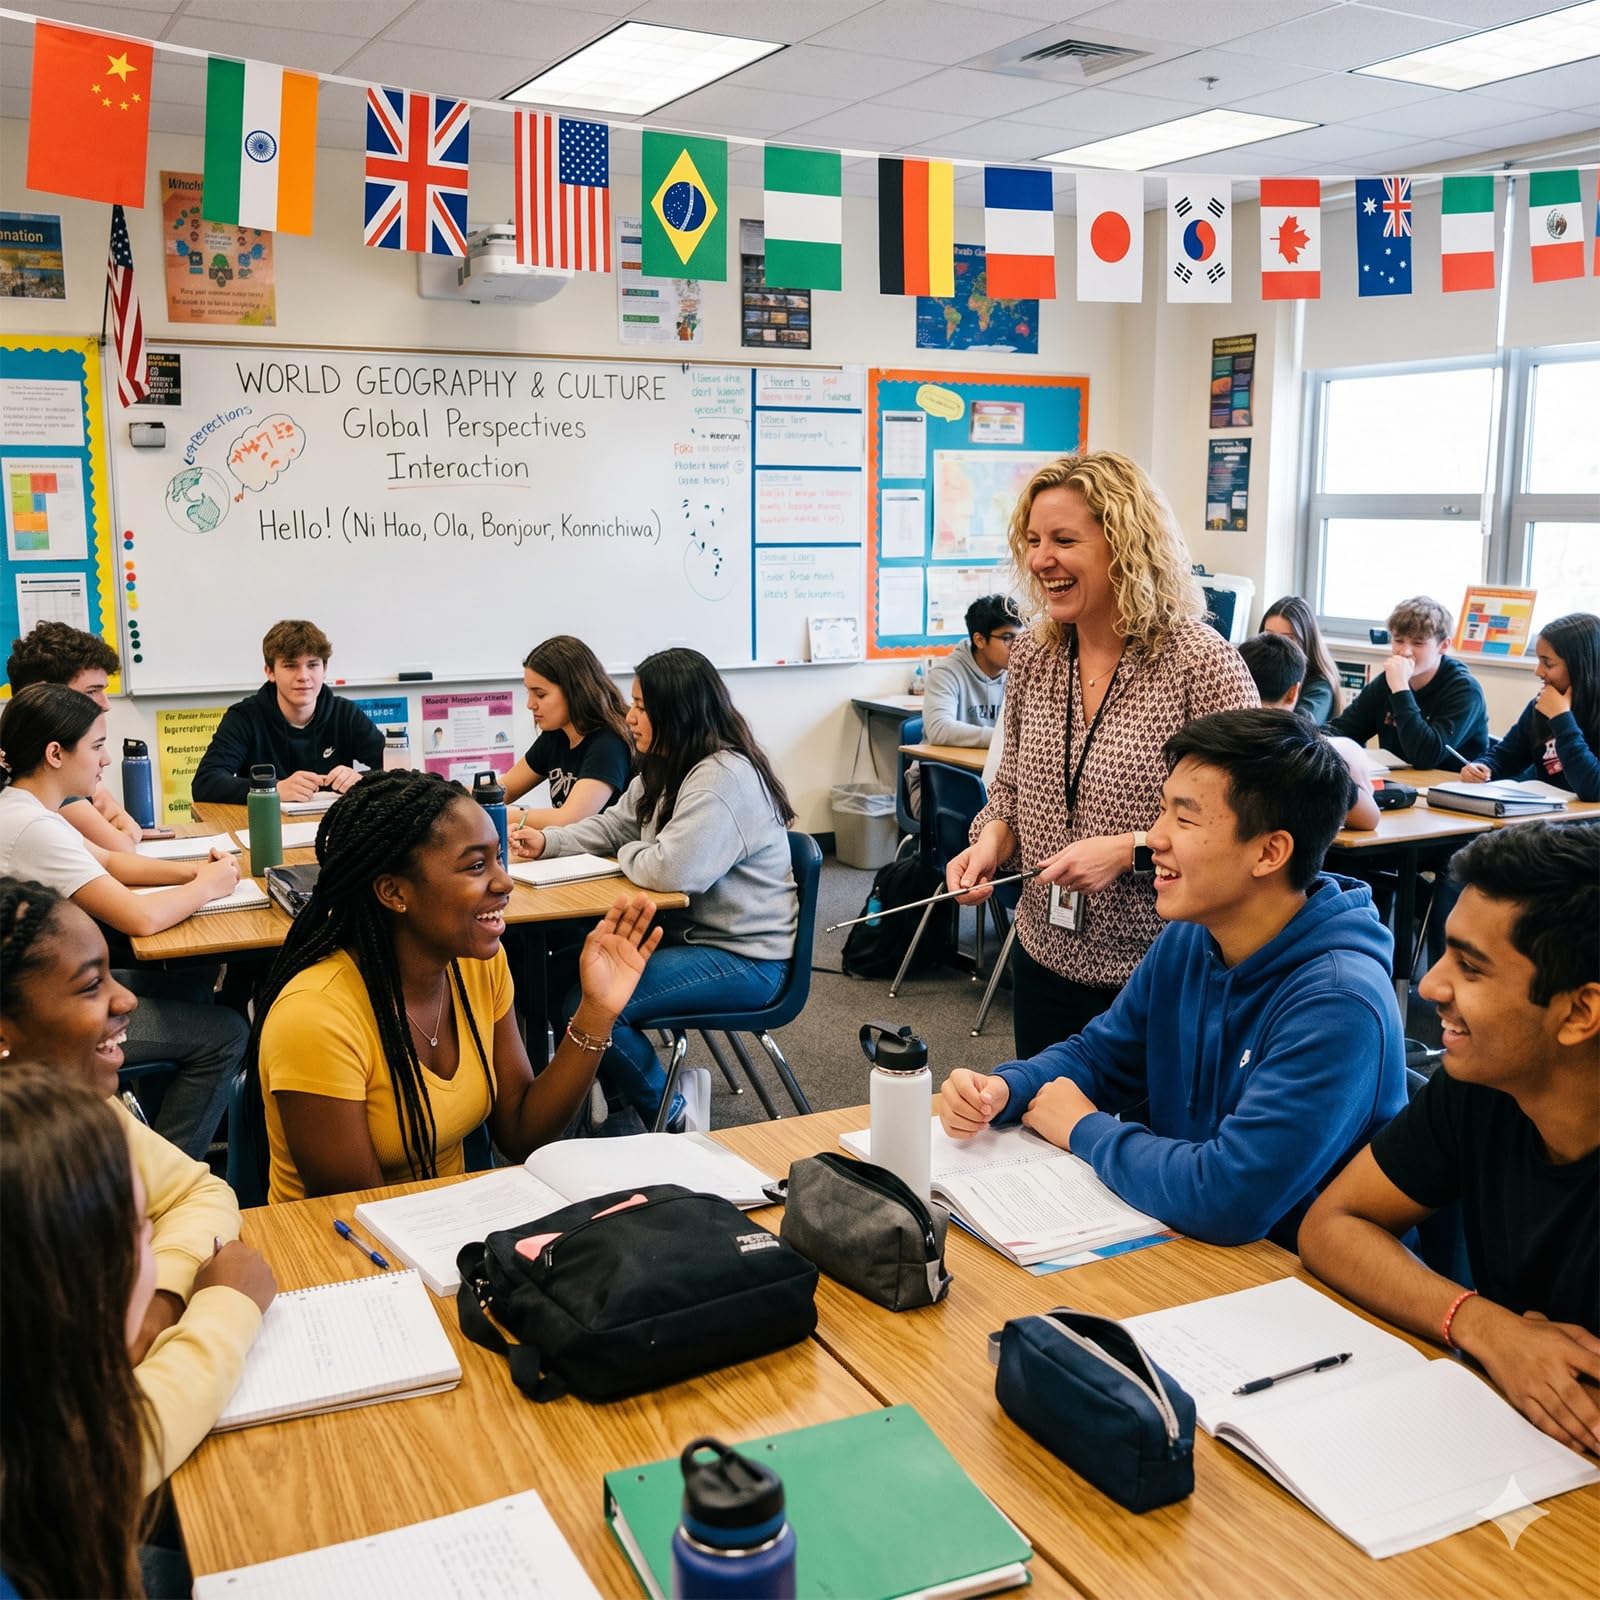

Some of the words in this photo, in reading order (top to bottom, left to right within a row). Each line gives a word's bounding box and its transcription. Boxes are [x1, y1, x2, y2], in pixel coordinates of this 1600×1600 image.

[236, 362, 341, 394] WORLD
[356, 365, 517, 399] GEOGRAPHY
[530, 371, 545, 399] &
[557, 372, 666, 401] CULTURE
[343, 407, 429, 439] Global
[446, 408, 587, 447] Perspectives
[386, 452, 529, 480] Interaction
[259, 507, 332, 541] Hello!
[342, 506, 375, 544] (Ni
[383, 511, 427, 542] Hao,
[433, 512, 475, 541] Ola,
[481, 511, 555, 546] Bonjour,
[561, 508, 662, 546] Konnichiwa)
